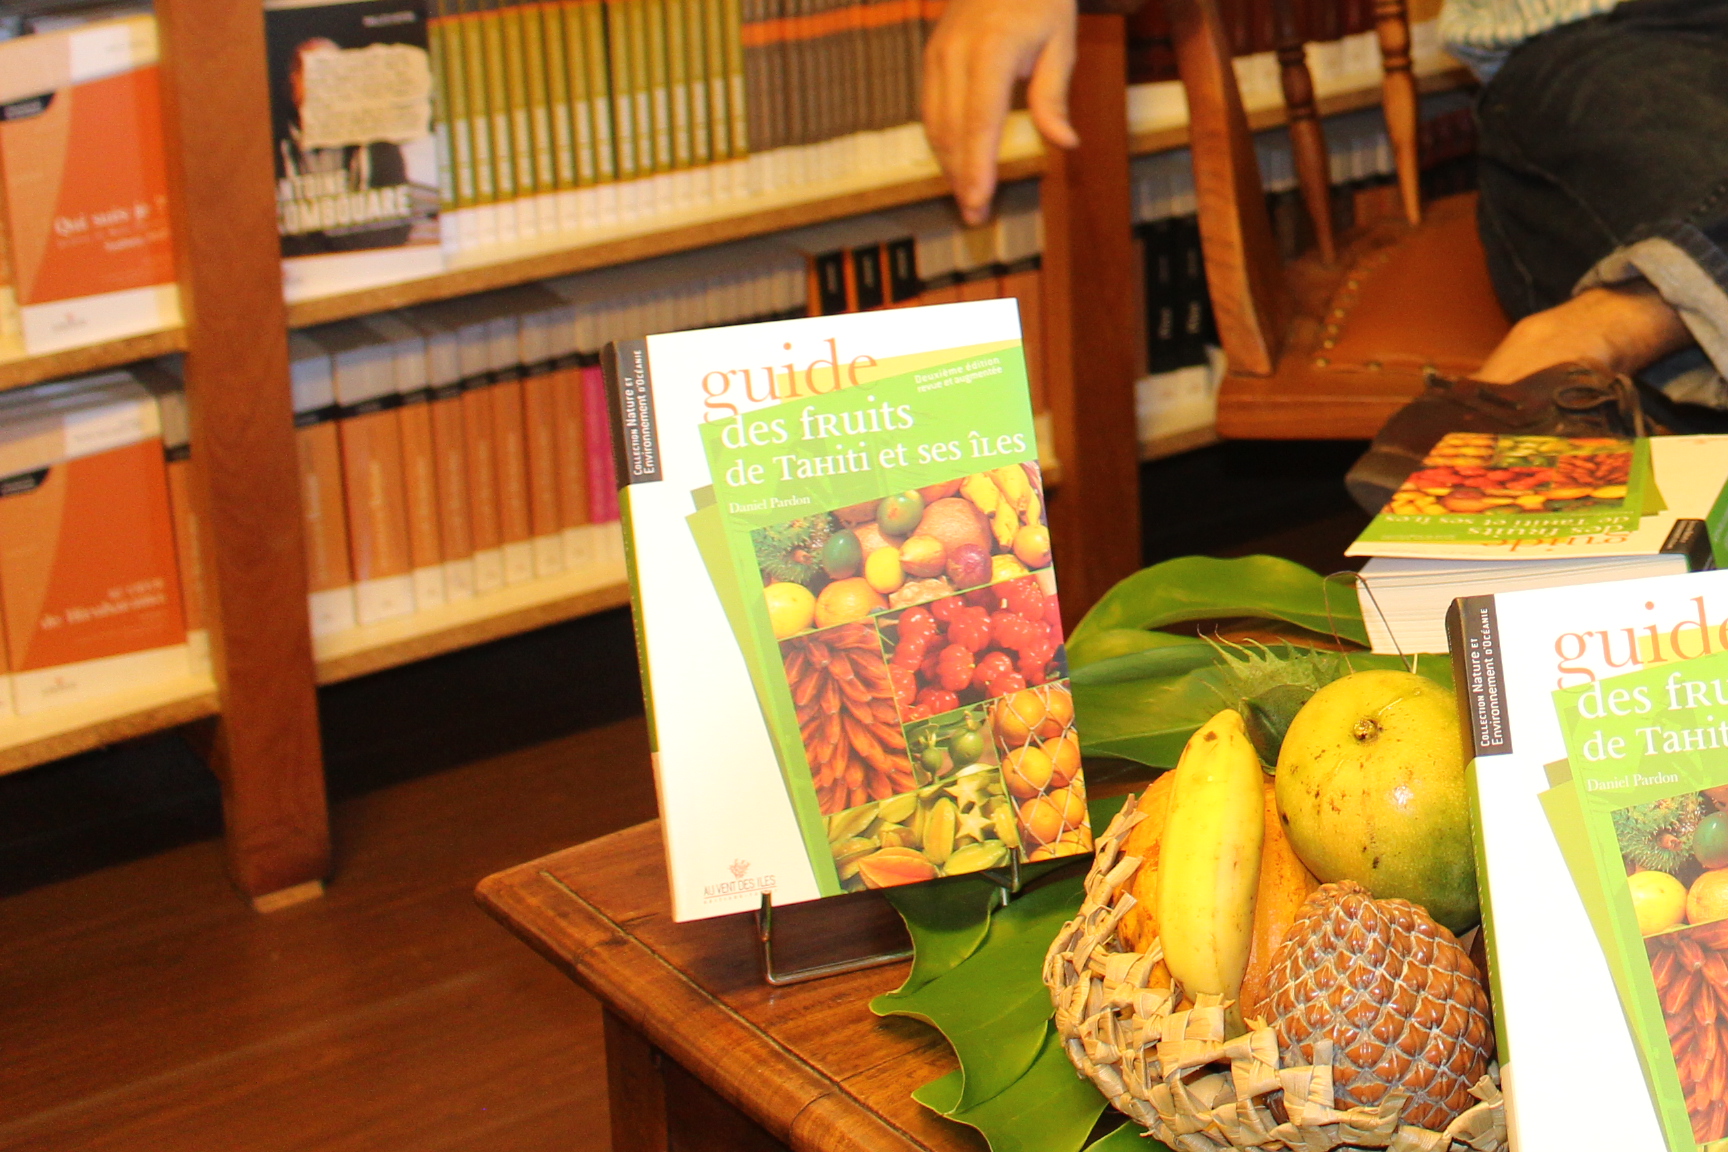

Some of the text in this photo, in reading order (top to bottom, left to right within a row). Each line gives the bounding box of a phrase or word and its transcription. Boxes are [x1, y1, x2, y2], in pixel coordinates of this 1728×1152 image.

[701, 337, 878, 425] guide
[914, 357, 1000, 384] Deuxième édition
[916, 366, 1004, 393] revue et augmentée
[624, 384, 638, 427] Nature
[637, 394, 656, 475] Environnement
[720, 411, 789, 450] des
[725, 458, 765, 488] de
[878, 444, 909, 470] et
[917, 438, 963, 466] ses
[728, 494, 811, 514] Daniel Pardon
[1471, 651, 1484, 694] Nature
[1484, 657, 1504, 747] Environnement
[1577, 679, 1653, 720] des
[1582, 732, 1627, 763] de
[1586, 770, 1679, 793] Daniel Pardon
[703, 886, 715, 896] AU
[716, 881, 736, 894] VENT
[738, 878, 755, 890] DES
